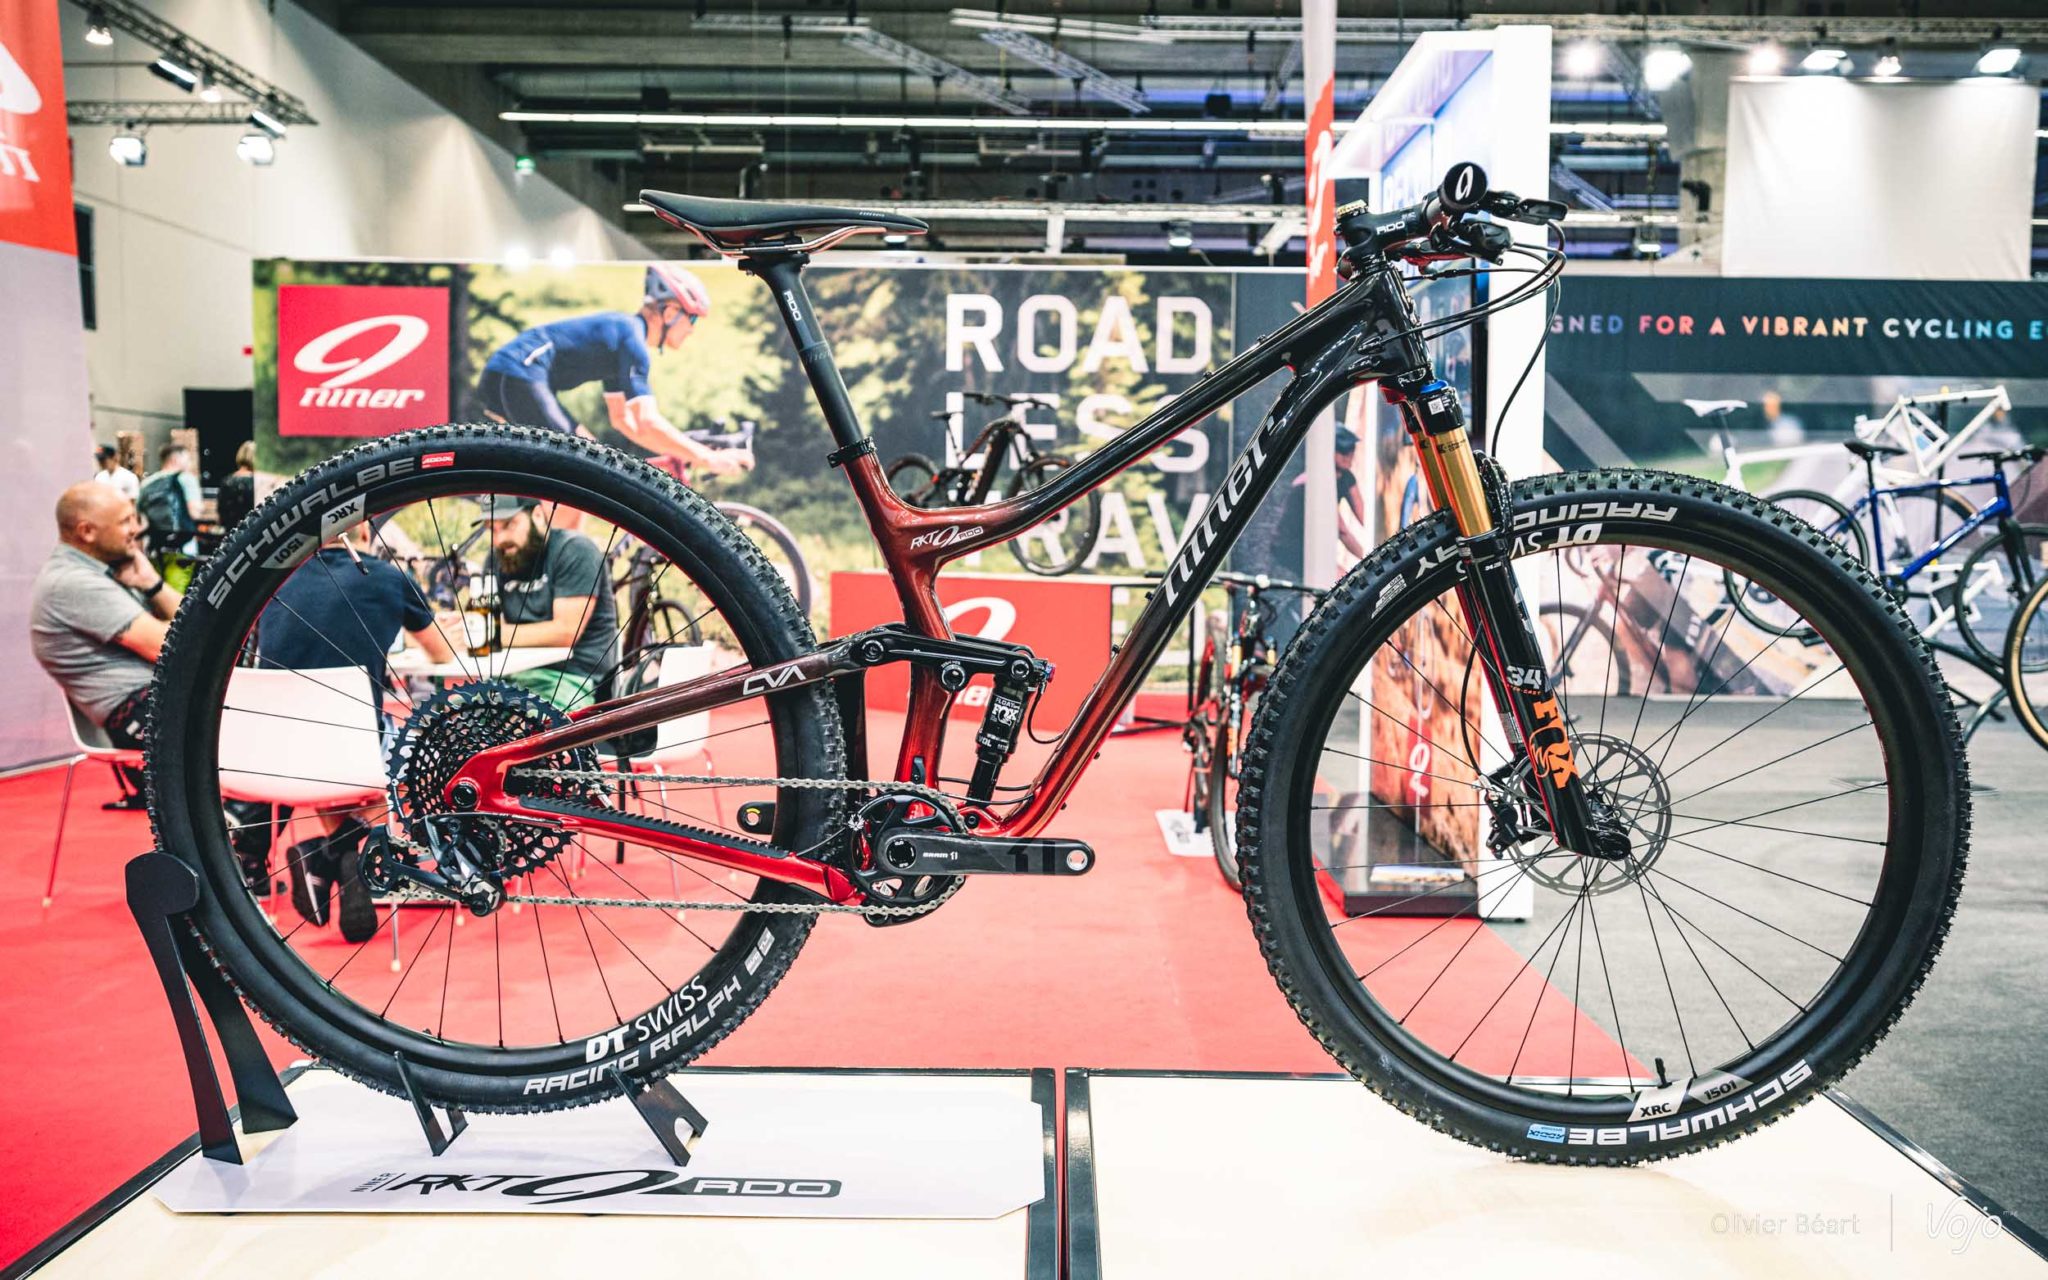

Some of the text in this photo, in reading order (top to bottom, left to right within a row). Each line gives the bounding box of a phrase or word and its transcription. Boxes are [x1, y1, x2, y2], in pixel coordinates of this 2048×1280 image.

[1376, 220, 1406, 236] RDO
[945, 293, 1213, 374] ROAD
[1638, 315, 1695, 336] FOR
[1709, 316, 1726, 336] A
[1742, 315, 1868, 338] VIBRANT
[1882, 317, 2014, 340] CYCLING
[299, 387, 426, 409] niner
[327, 501, 359, 525] XRC
[1161, 414, 1276, 608] niner
[206, 456, 416, 610] SCHWALBE
[1547, 522, 1603, 550] DT
[274, 537, 305, 565] 1501
[742, 664, 807, 696] CVA
[1506, 664, 1543, 691] 34
[991, 702, 1020, 727] FOX
[1528, 695, 1580, 790] FOX
[585, 975, 708, 1064] DT SWISS
[522, 975, 743, 1096] RACING RALPH
[1567, 1058, 1813, 1146] SCHWALBE
[1703, 1079, 1738, 1100] 1501
[1640, 1102, 1673, 1119] XRC
